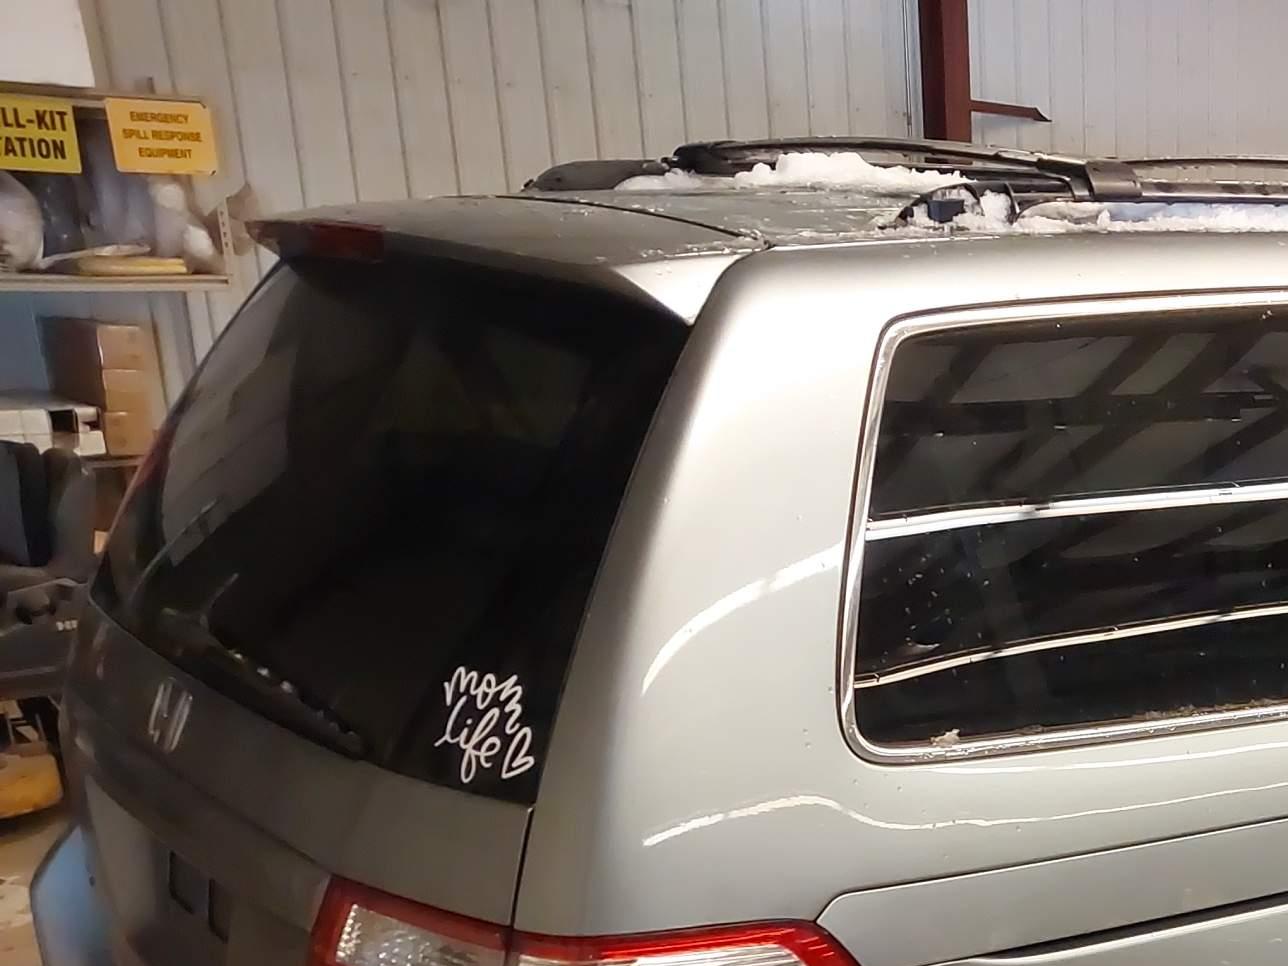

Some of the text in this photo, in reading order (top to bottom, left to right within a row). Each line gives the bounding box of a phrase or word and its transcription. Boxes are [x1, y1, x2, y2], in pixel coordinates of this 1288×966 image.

[0, 106, 68, 132] LL-KIT
[129, 111, 188, 123] EMERGENCY
[122, 128, 202, 142] SPILL RESPONSE
[138, 147, 192, 159] EQUIPMENT
[433, 695, 501, 783] life
